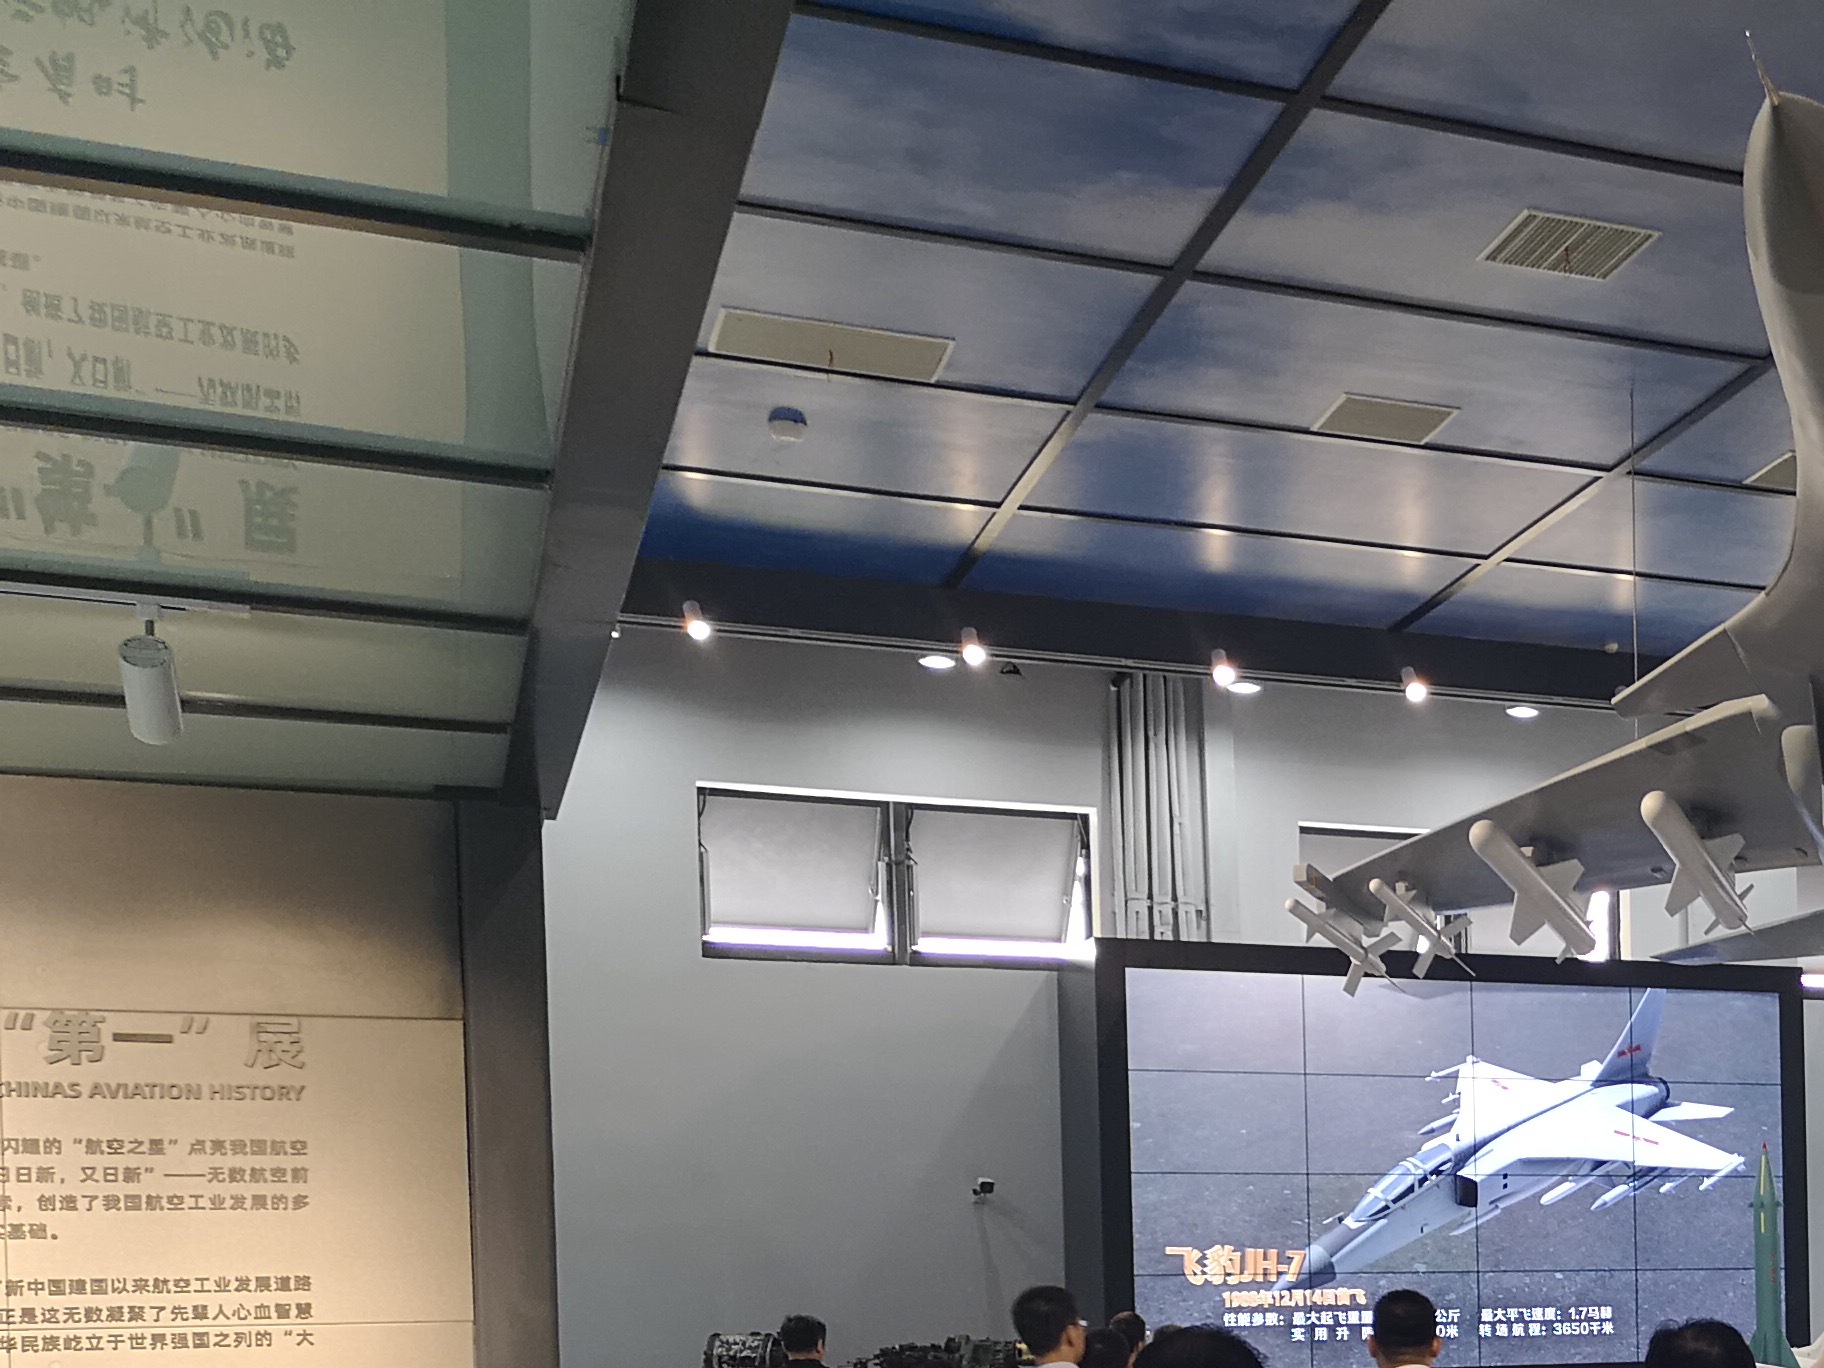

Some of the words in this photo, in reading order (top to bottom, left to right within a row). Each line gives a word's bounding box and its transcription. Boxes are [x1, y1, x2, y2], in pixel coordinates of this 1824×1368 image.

[0, 1081, 82, 1099] HINAS
[89, 1083, 202, 1101] AVIATION
[209, 1085, 306, 1101] HISTORY
[0, 1222, 58, 1241] 基础。
[1165, 1244, 1306, 1285] 飞豹JH-7
[0, 1275, 312, 1297] 新中国建国以来航空工业发展道路
